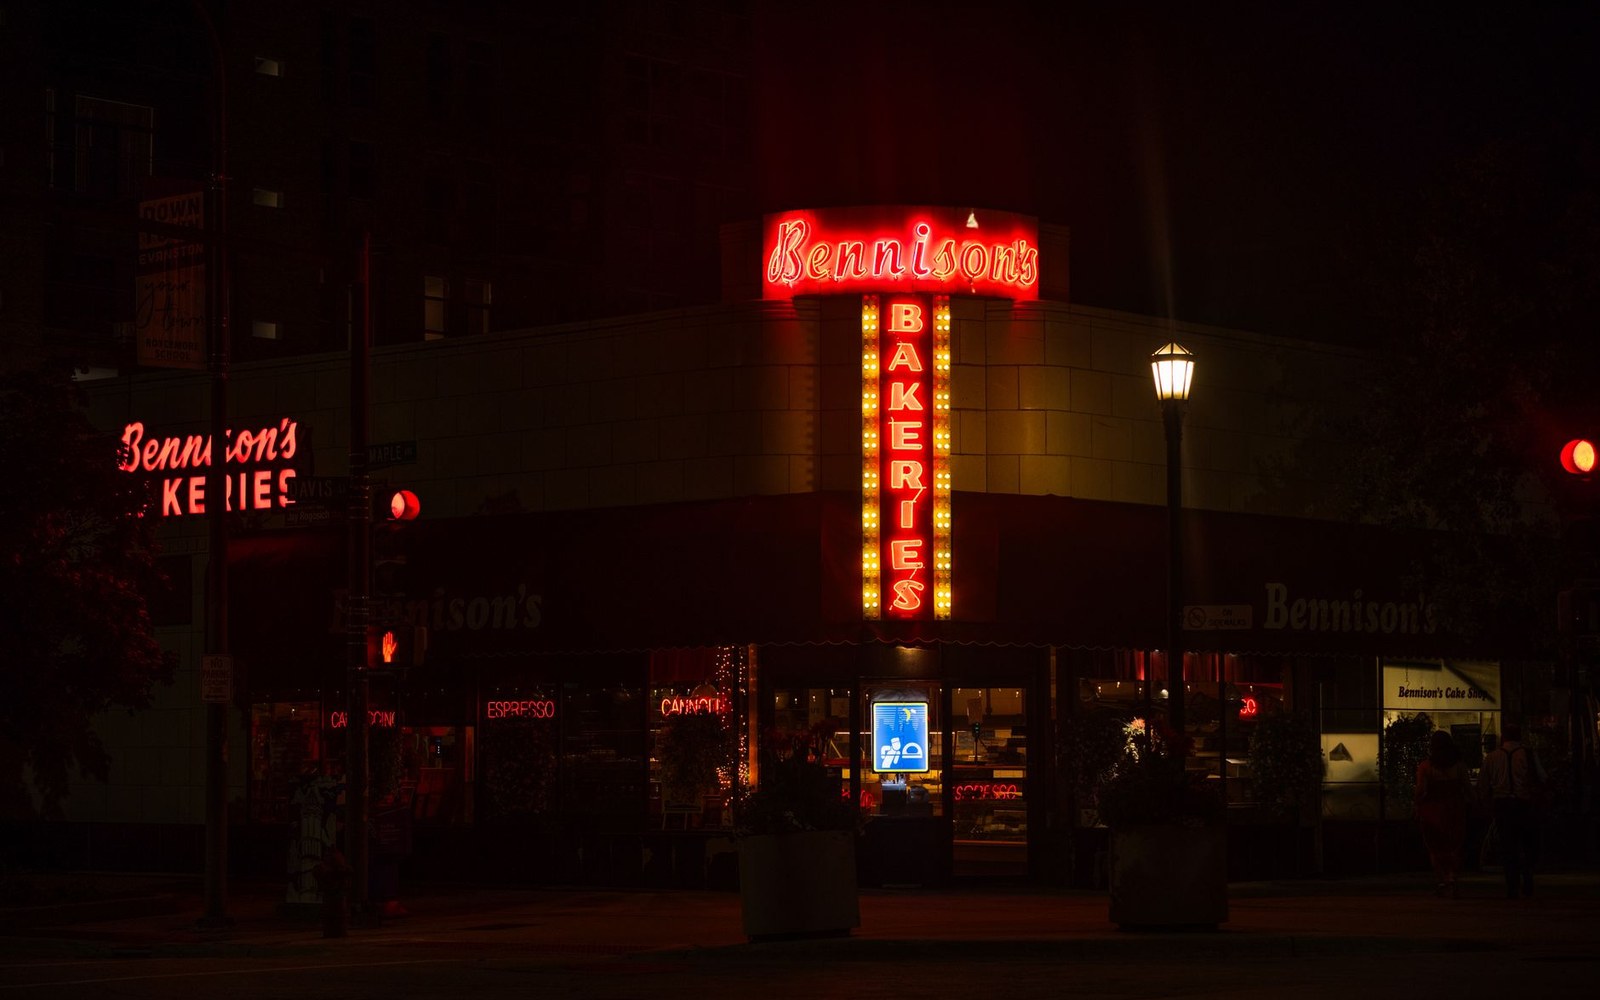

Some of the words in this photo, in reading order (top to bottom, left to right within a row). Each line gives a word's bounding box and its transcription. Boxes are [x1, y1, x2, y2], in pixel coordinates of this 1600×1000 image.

[767, 220, 1038, 286] Bennison's
[368, 444, 402, 465] MAPLE
[886, 303, 925, 610] BAKERIES
[289, 480, 332, 498] DAVIS
[1264, 582, 1437, 634] Bennison's
[1397, 685, 1444, 699] Bennison's
[1445, 686, 1466, 699] Cake
[1467, 686, 1489, 700] Shop
[487, 700, 555, 719] ESPRESSO
